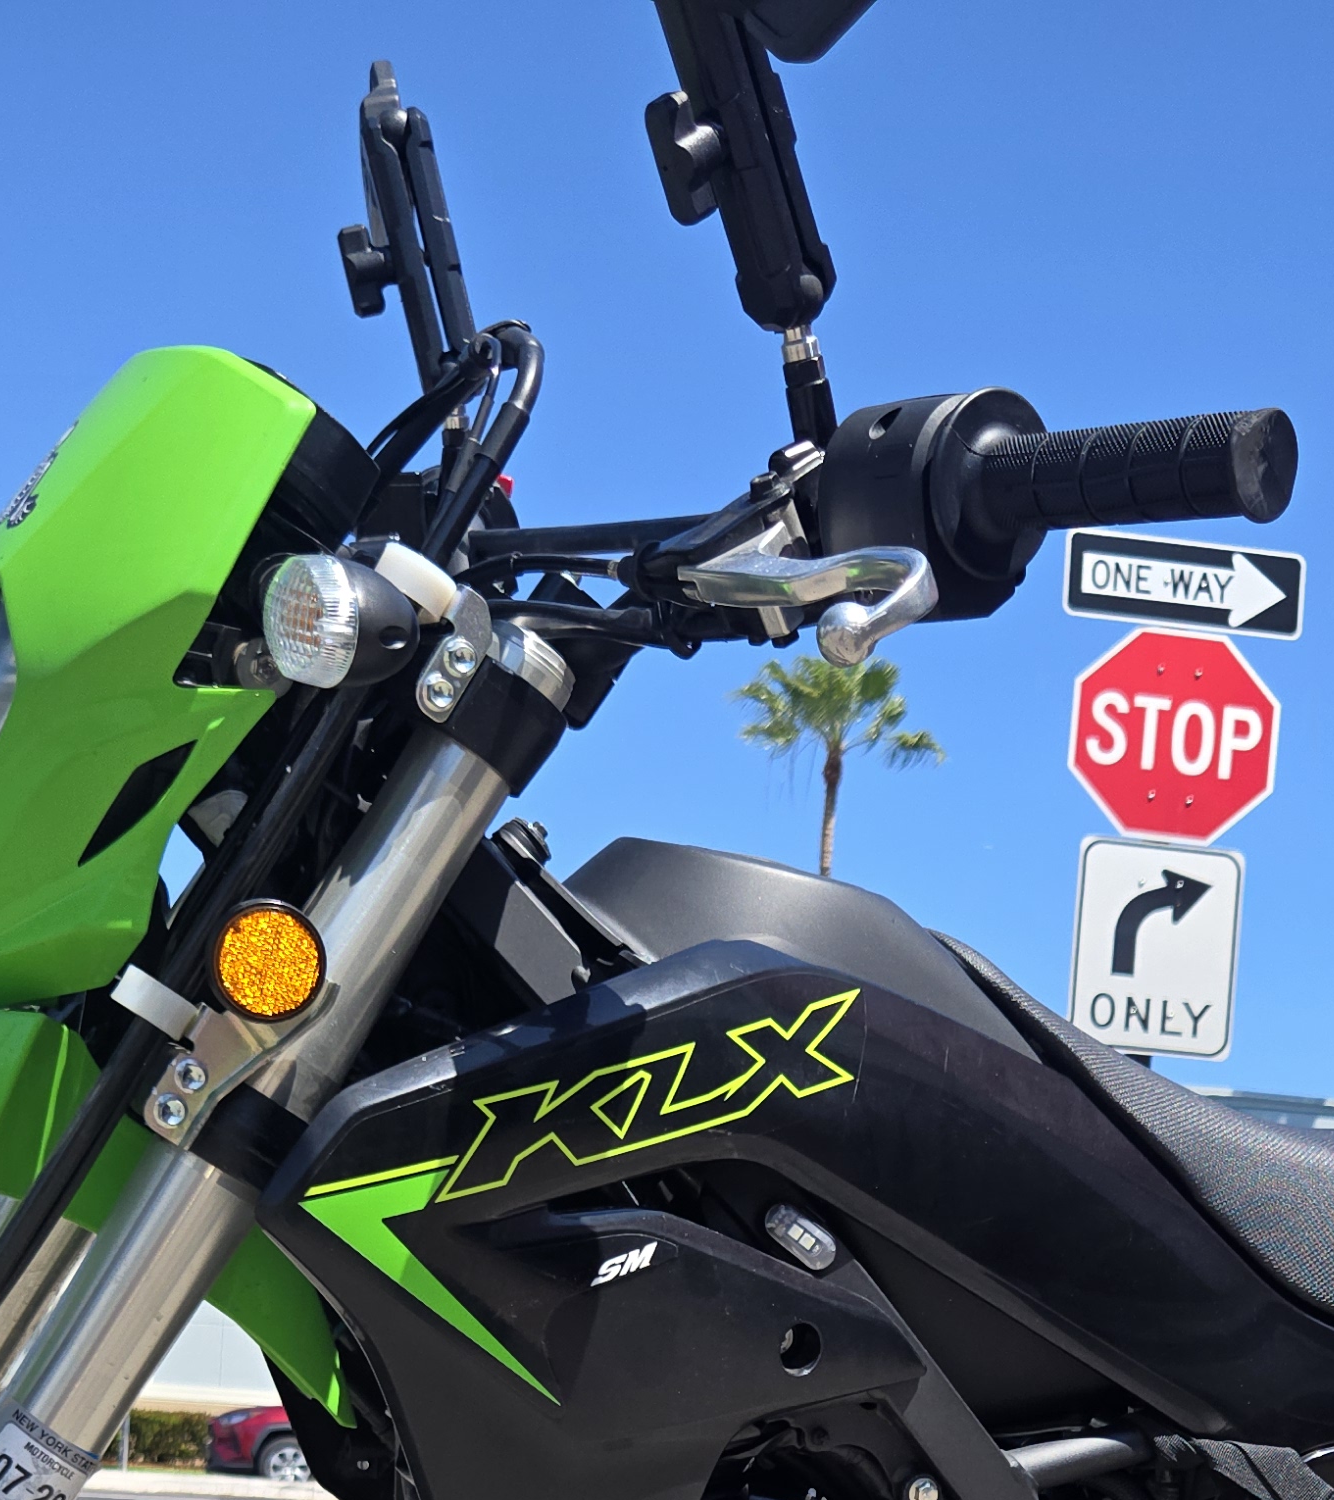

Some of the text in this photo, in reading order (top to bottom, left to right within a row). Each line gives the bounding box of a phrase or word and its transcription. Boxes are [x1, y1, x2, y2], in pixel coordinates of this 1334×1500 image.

[1091, 559, 1233, 604] ONE WAY
[1086, 690, 1264, 780] STOP
[1090, 992, 1211, 1038] ONLY
[436, 988, 860, 1203] KLX
[591, 1241, 658, 1287] SM
[12, 1409, 97, 1473] NEW YORK STAT
[24, 1441, 76, 1480] MOTORCYCLE
